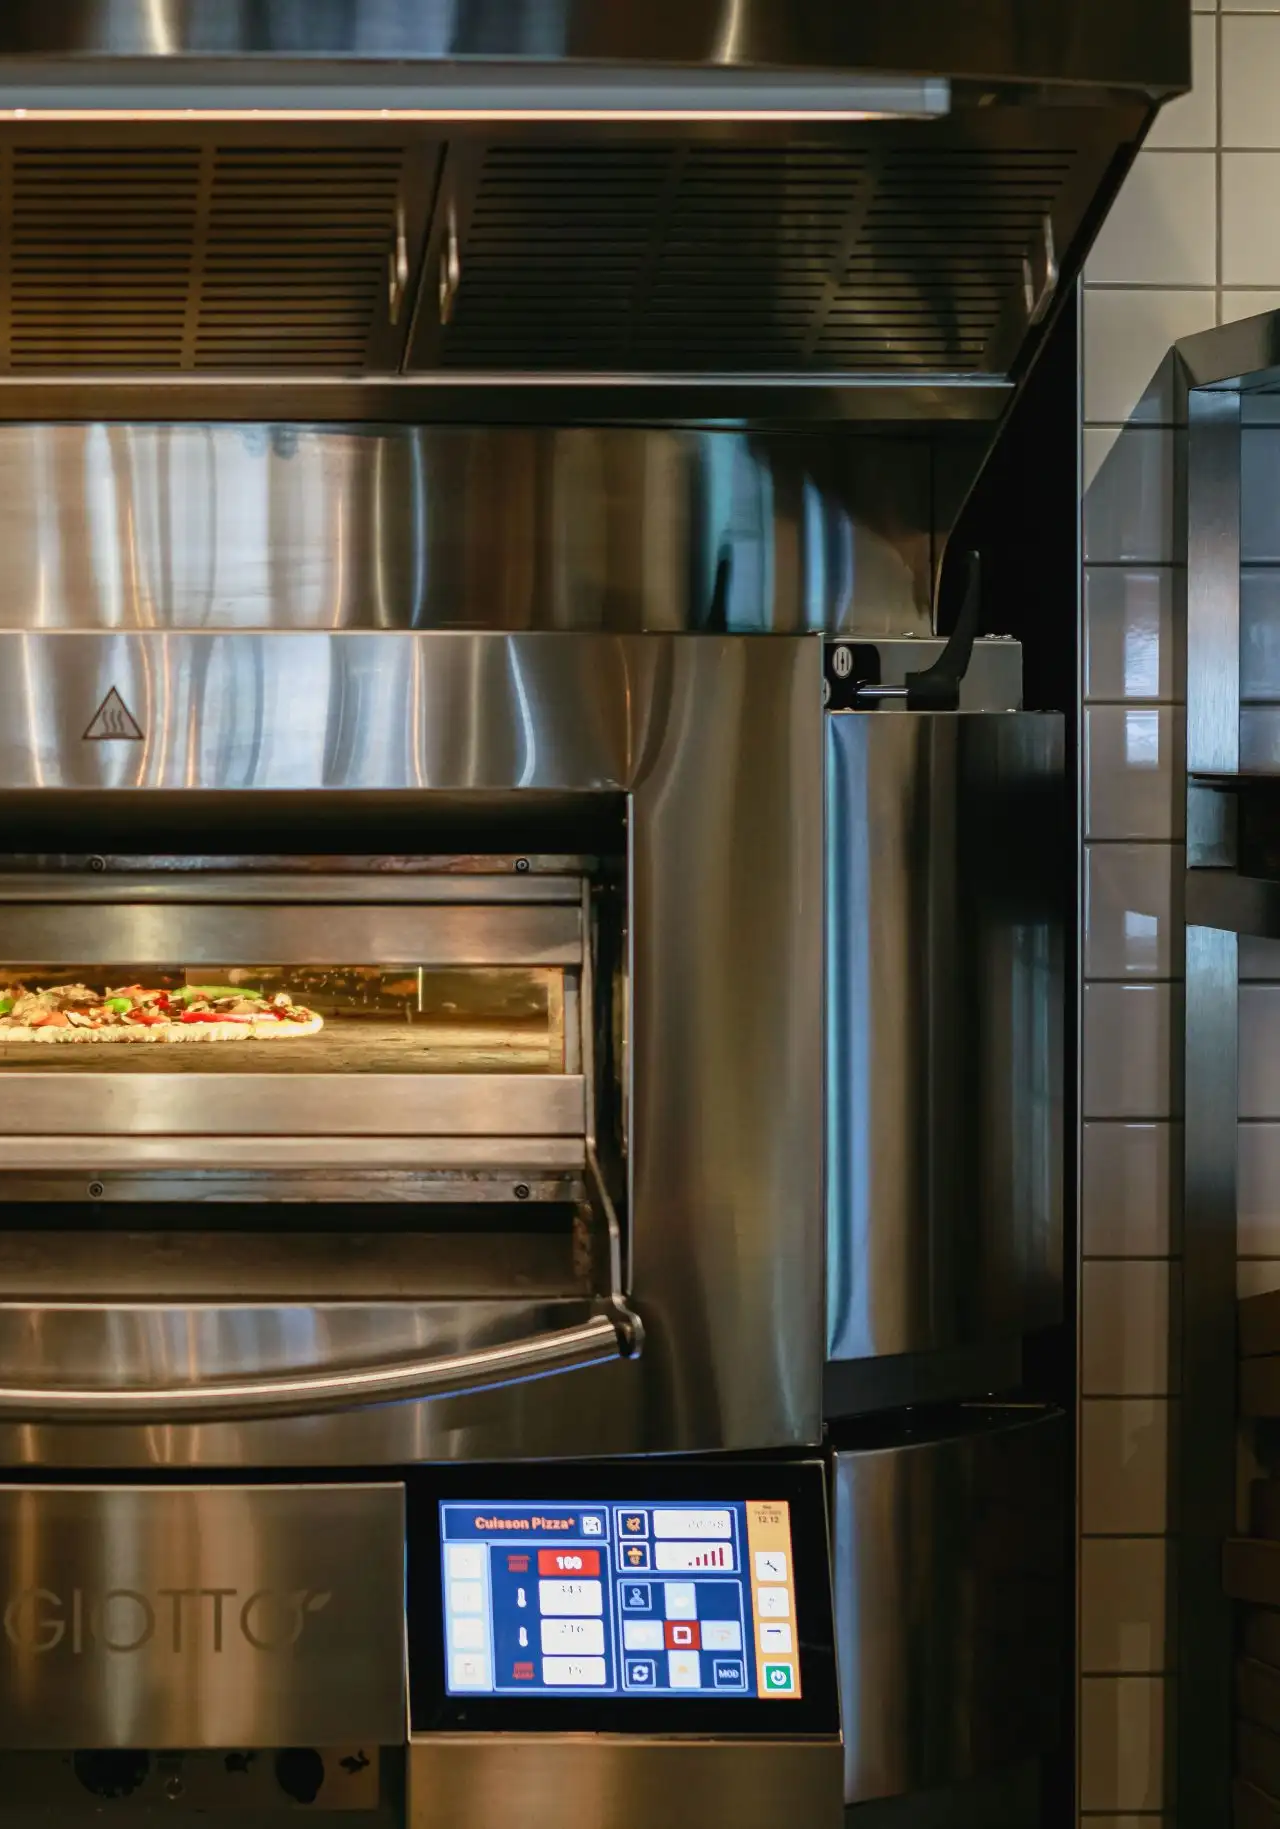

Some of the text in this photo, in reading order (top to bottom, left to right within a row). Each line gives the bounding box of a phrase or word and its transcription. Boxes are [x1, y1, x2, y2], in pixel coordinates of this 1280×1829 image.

[475, 1516, 529, 1530] Cuisson
[556, 1556, 582, 1570] 100
[3, 1588, 305, 1654] GIOTTO
[718, 1668, 740, 1680] MOD
